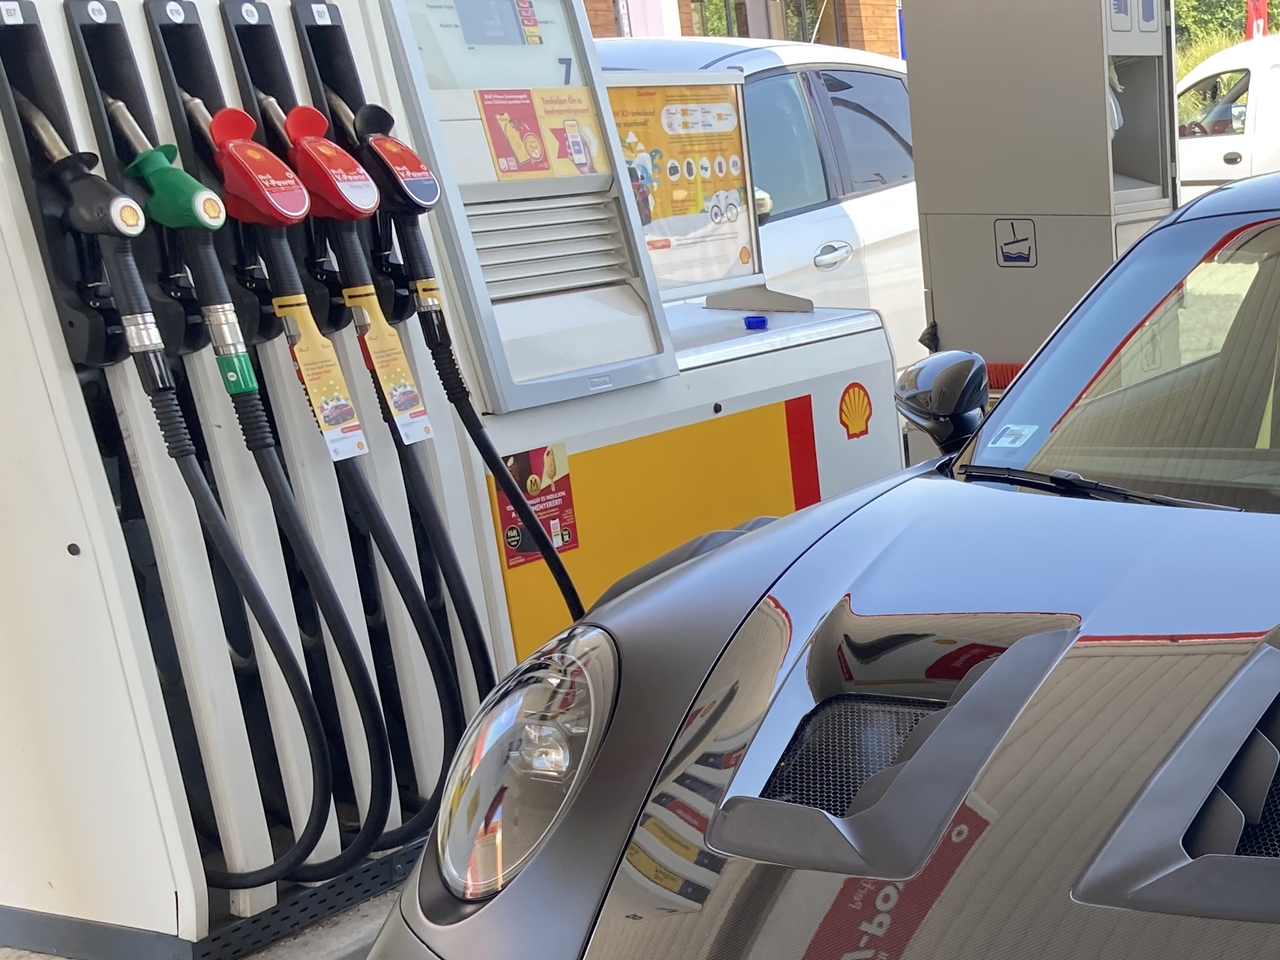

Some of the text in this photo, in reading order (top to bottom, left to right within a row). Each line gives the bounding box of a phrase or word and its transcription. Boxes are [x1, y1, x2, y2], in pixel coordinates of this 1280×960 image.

[92, 8, 104, 16] E10
[558, 58, 572, 85] 7
[335, 173, 366, 181] V-Power
[399, 170, 429, 178] V-Power
[261, 179, 296, 187] V-Power
